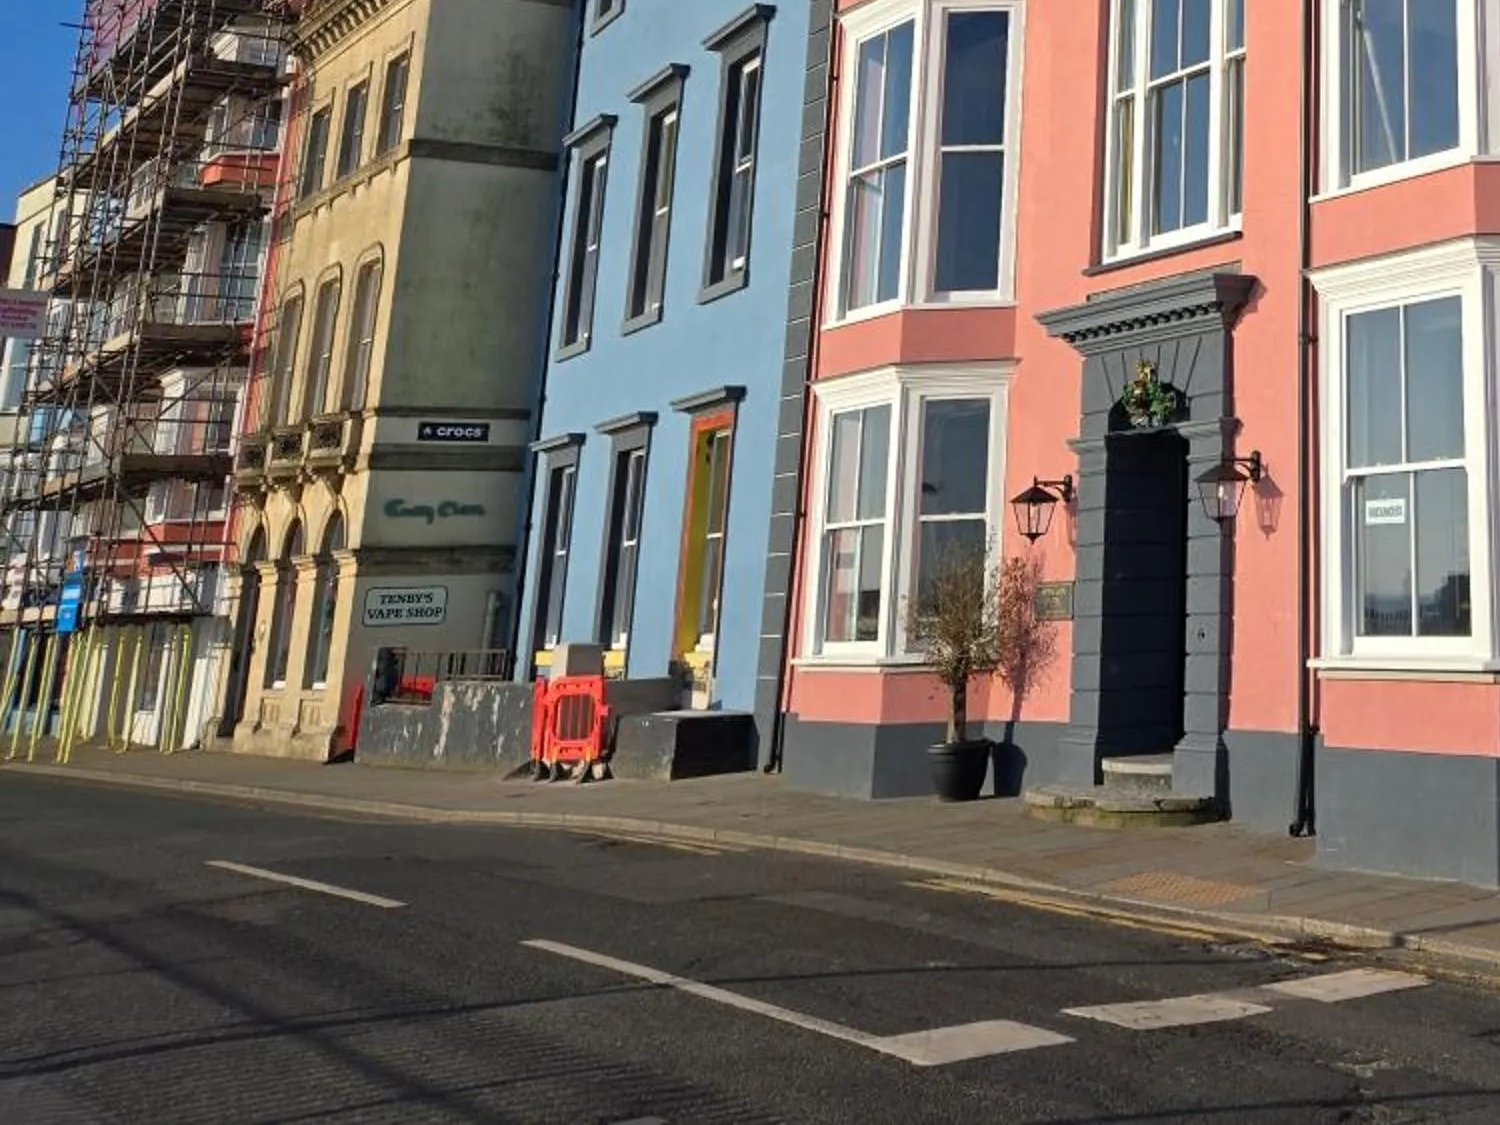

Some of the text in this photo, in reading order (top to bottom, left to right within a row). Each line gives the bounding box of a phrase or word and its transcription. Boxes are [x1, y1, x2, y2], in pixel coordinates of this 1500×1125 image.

[436, 426, 483, 438] crocs
[379, 593, 433, 605] TENBY'S
[367, 607, 443, 620] VAPE SHOP
